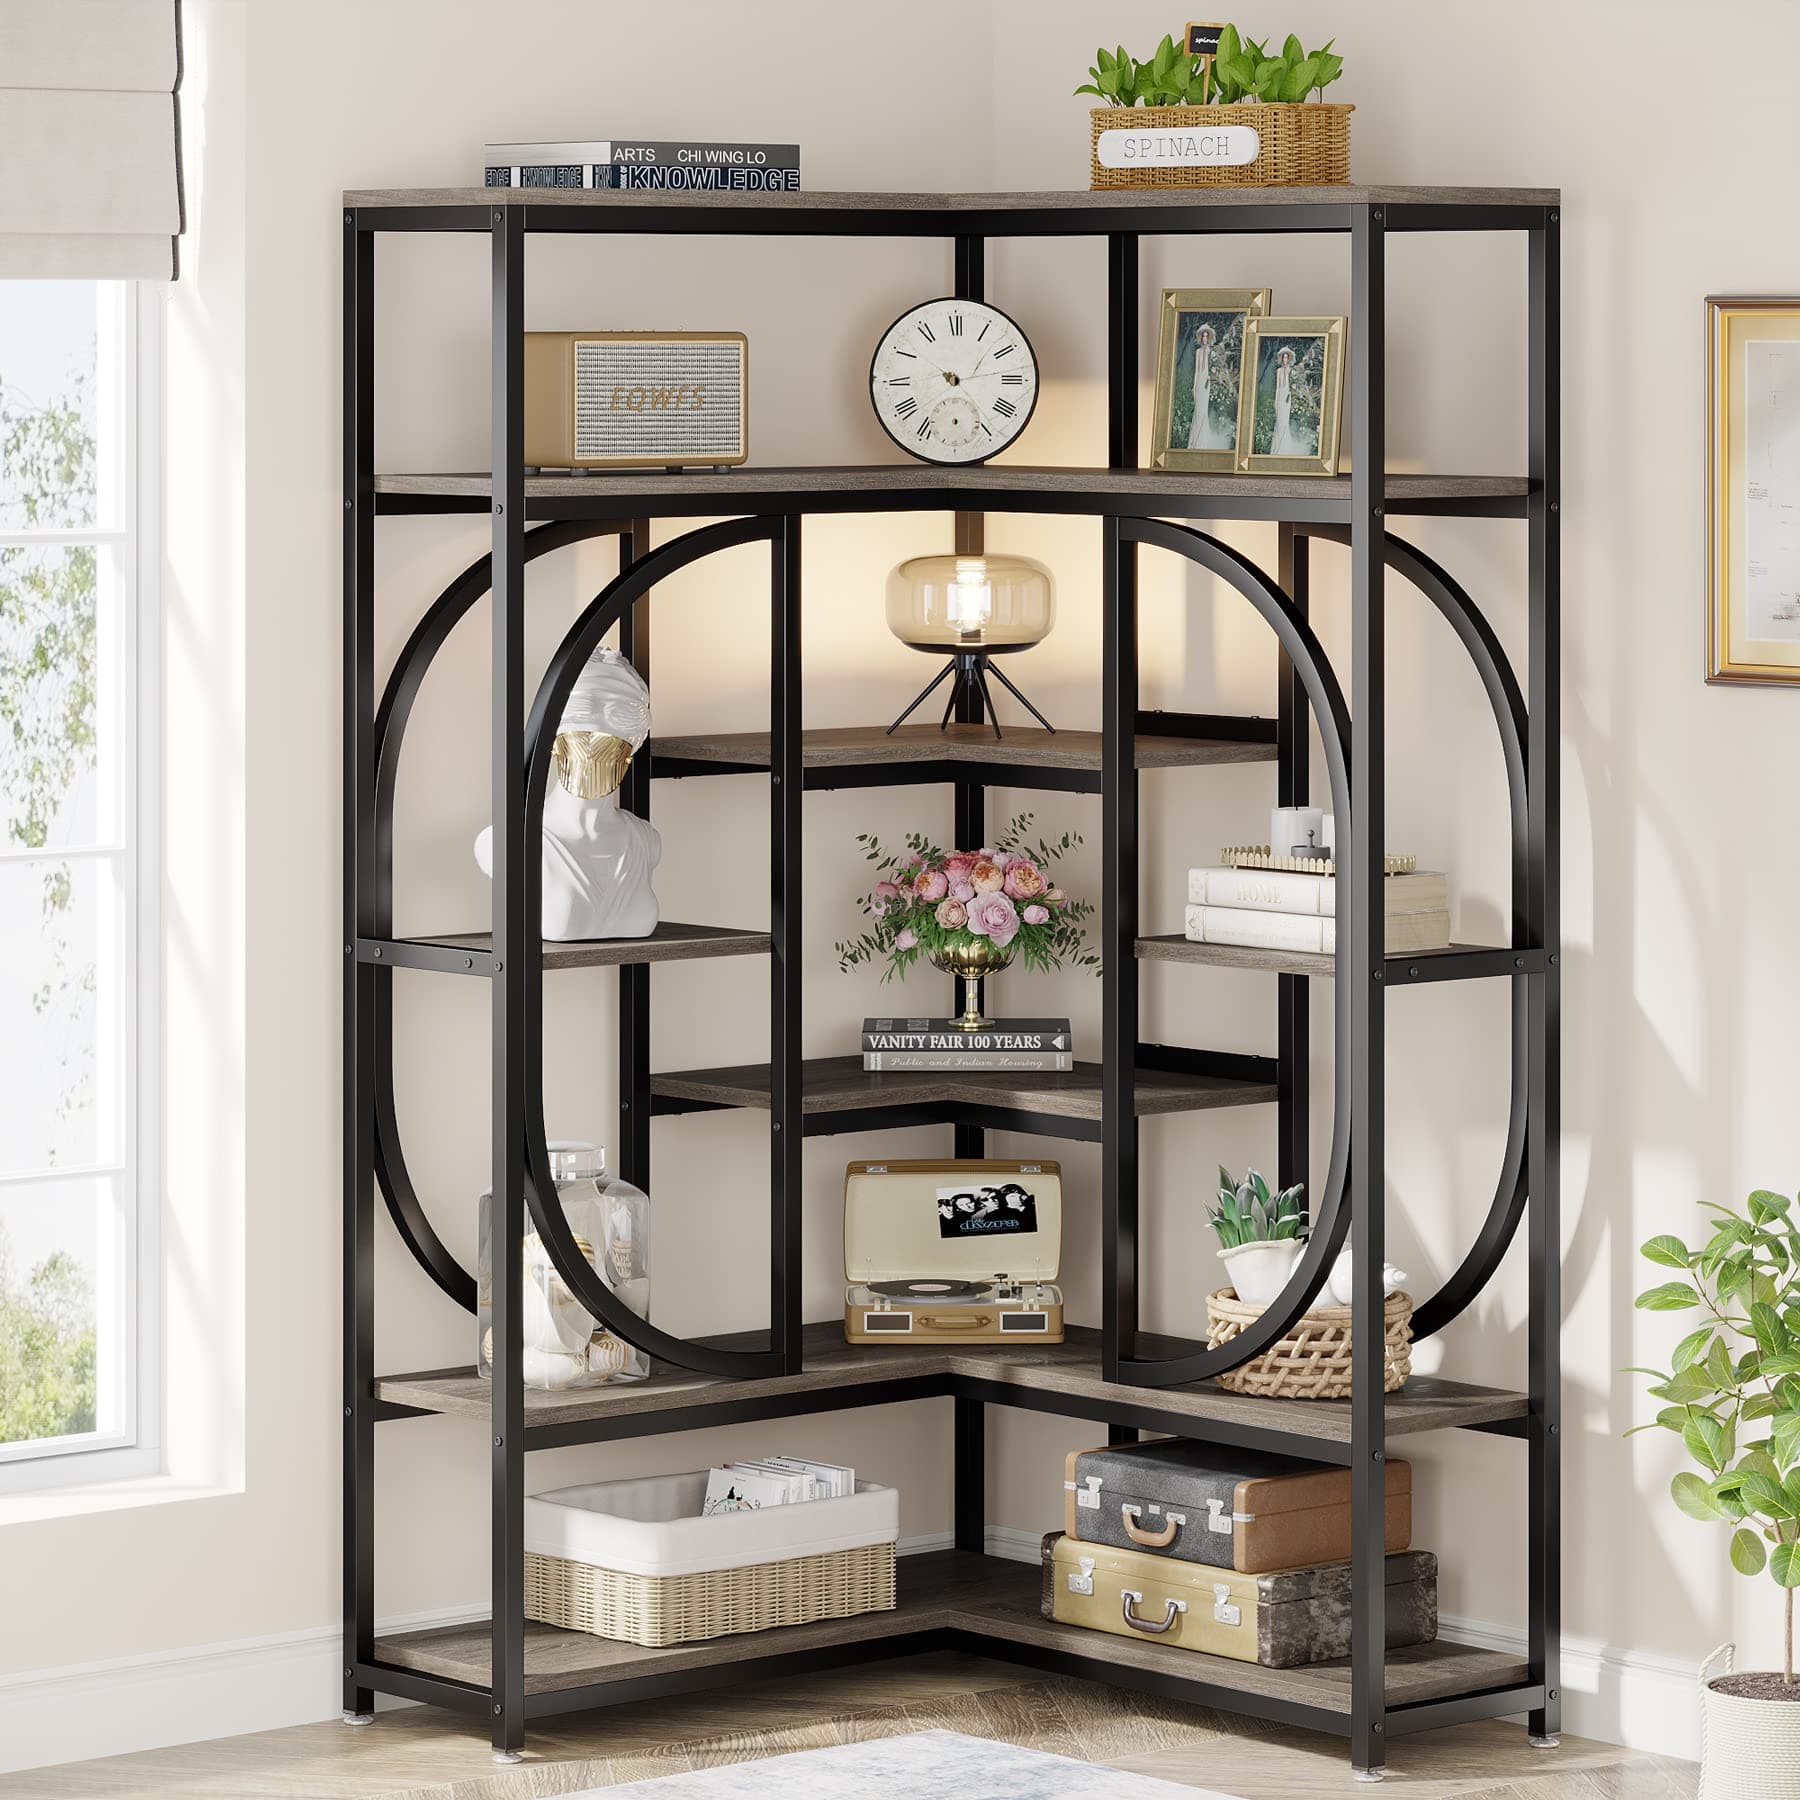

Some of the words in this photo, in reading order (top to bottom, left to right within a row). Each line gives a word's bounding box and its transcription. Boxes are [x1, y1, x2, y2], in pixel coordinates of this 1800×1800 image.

[1123, 136, 1230, 159] SPINACH
[613, 148, 656, 162] ARTS
[677, 149, 702, 163] CHI
[705, 150, 744, 164] WING
[747, 151, 767, 164] LO
[629, 165, 800, 192] KNOWLEDGE
[868, 1034, 927, 1049] VANITY
[929, 1034, 964, 1049] FAIR
[967, 1035, 991, 1049] 100
[993, 1034, 1042, 1049] YEARS
[890, 1057, 923, 1067] Public
[928, 1057, 952, 1067] and
[955, 1056, 993, 1067] Indian
[997, 1057, 1044, 1070] Housing
